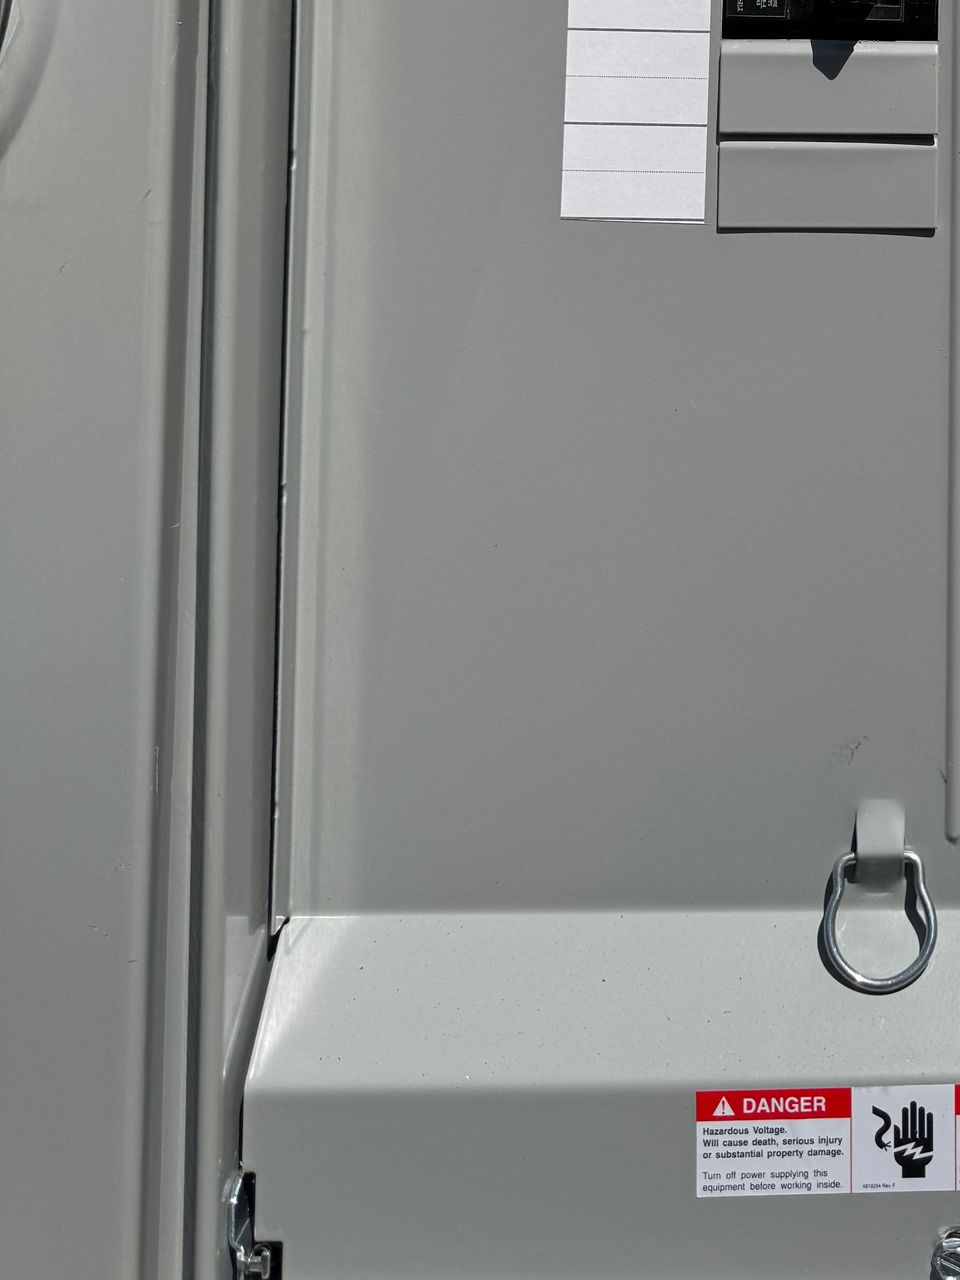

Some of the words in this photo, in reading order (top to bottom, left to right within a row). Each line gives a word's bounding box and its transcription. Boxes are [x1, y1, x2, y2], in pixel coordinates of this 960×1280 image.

[743, 1096, 825, 1113] DANGER
[703, 1127, 749, 1135] Hazardous
[753, 1126, 787, 1135] Voltage.
[703, 1139, 719, 1147] Will
[752, 1138, 779, 1146] death,
[783, 1137, 814, 1145] serious
[818, 1136, 842, 1146] injury
[716, 1150, 763, 1158] substantial
[767, 1150, 803, 1159] property
[808, 1148, 844, 1157] damage.
[703, 1172, 721, 1180] Turn
[741, 1172, 765, 1180] power
[771, 1170, 808, 1180] supplying
[814, 1169, 828, 1177] this
[703, 1183, 745, 1193] equipment
[750, 1182, 775, 1190] before
[781, 1182, 811, 1191] working
[817, 1180, 843, 1189] inside.
